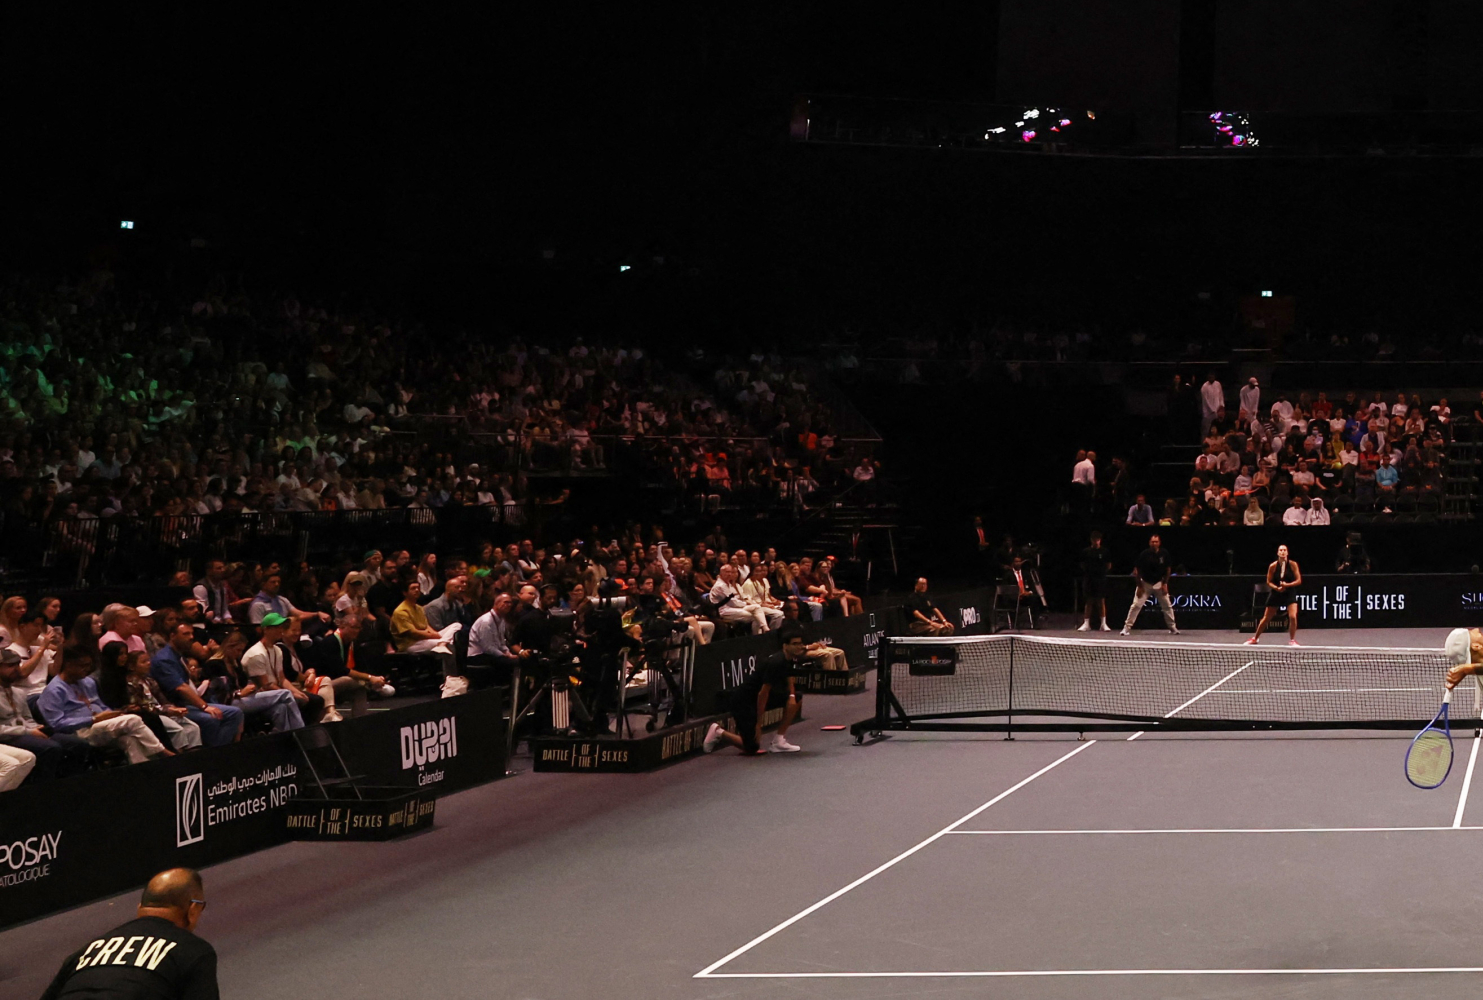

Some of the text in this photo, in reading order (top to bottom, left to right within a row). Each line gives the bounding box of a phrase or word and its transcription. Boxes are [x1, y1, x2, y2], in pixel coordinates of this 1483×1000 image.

[1336, 585, 1349, 602] OF
[1366, 594, 1405, 610] SEXES
[1332, 603, 1352, 620] THE
[400, 716, 457, 770] DUBAI
[601, 751, 628, 762] SEXES
[283, 764, 297, 778] بنك
[418, 769, 445, 787] Calendar
[207, 777, 237, 800] الوطني
[238, 777, 255, 792] دبي
[208, 784, 298, 826] Emirates NBD
[287, 808, 383, 835] BATTLE OF THE SEXES
[75, 936, 177, 971] CREW
